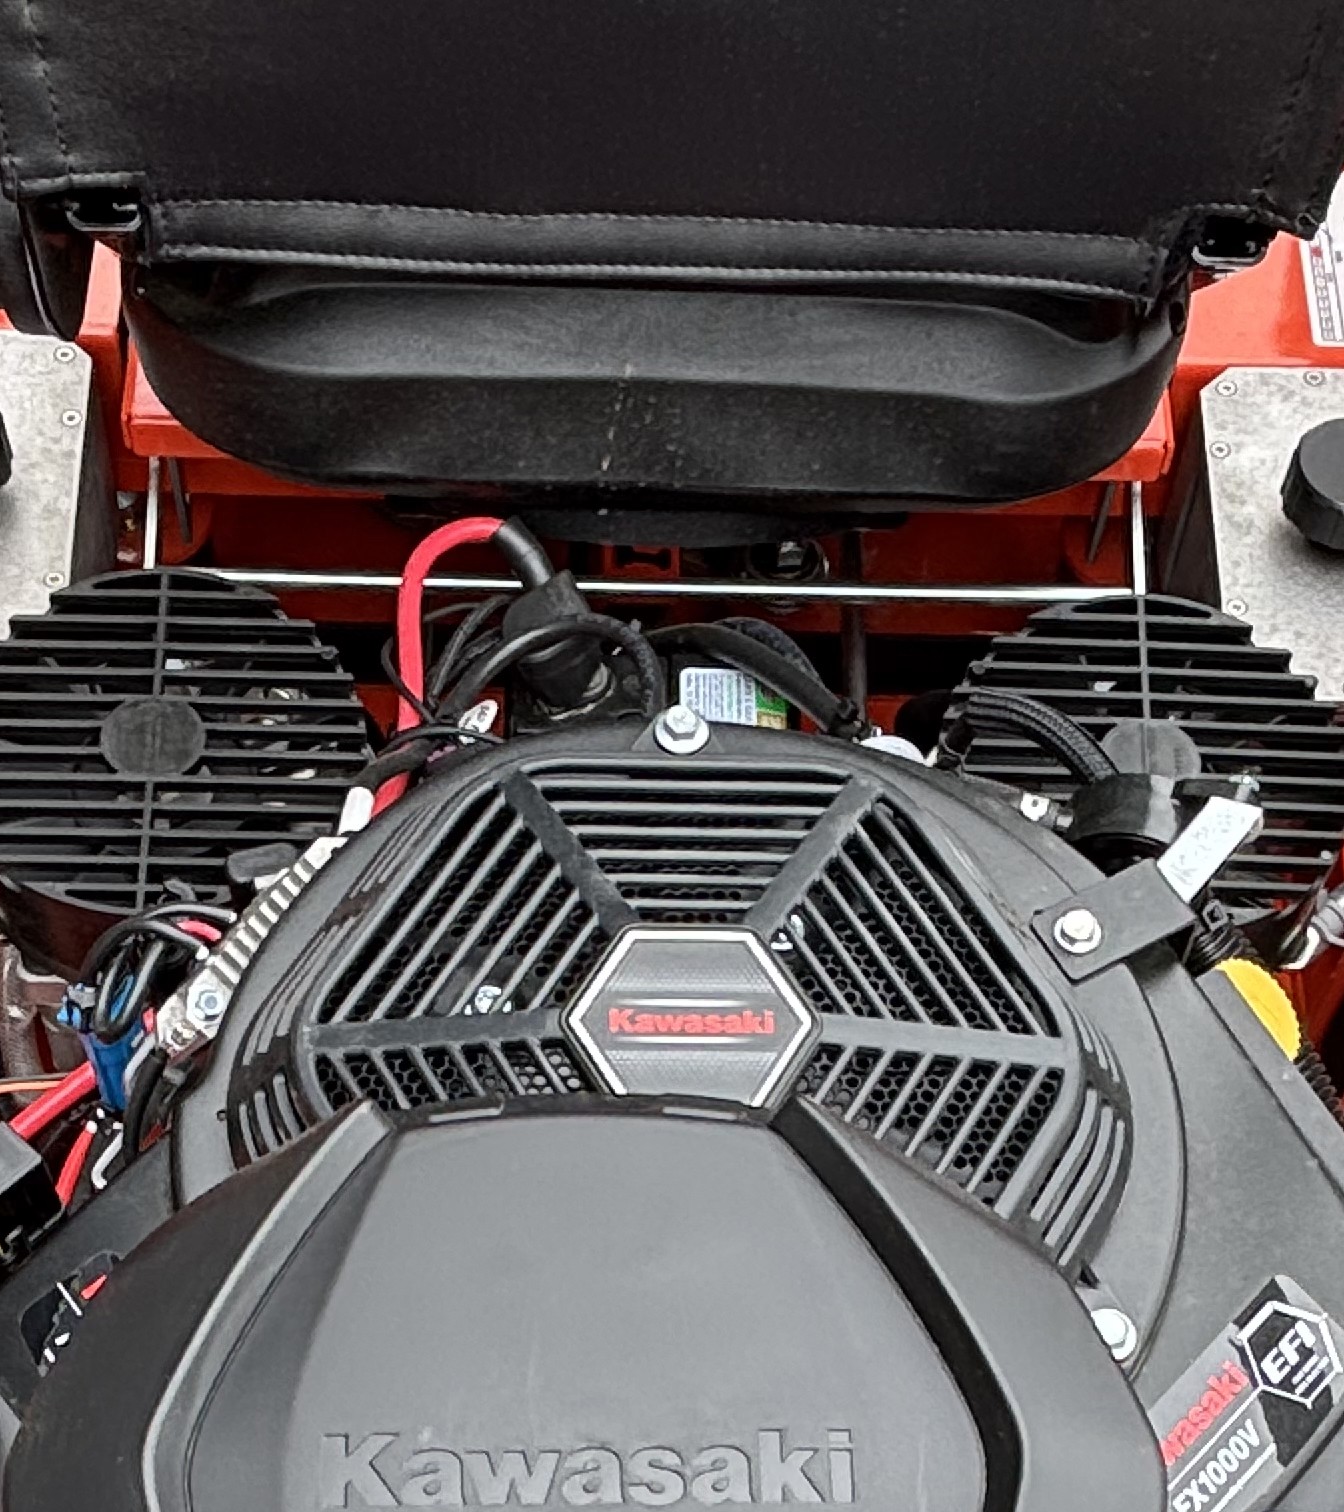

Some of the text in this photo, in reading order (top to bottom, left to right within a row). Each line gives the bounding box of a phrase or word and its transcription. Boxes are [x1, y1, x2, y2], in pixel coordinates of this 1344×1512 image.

[607, 1008, 775, 1034] Kawasaki
[1260, 1319, 1316, 1385] EFI
[1161, 1360, 1250, 1466] wasaki
[321, 1427, 855, 1508] Kawasaki
